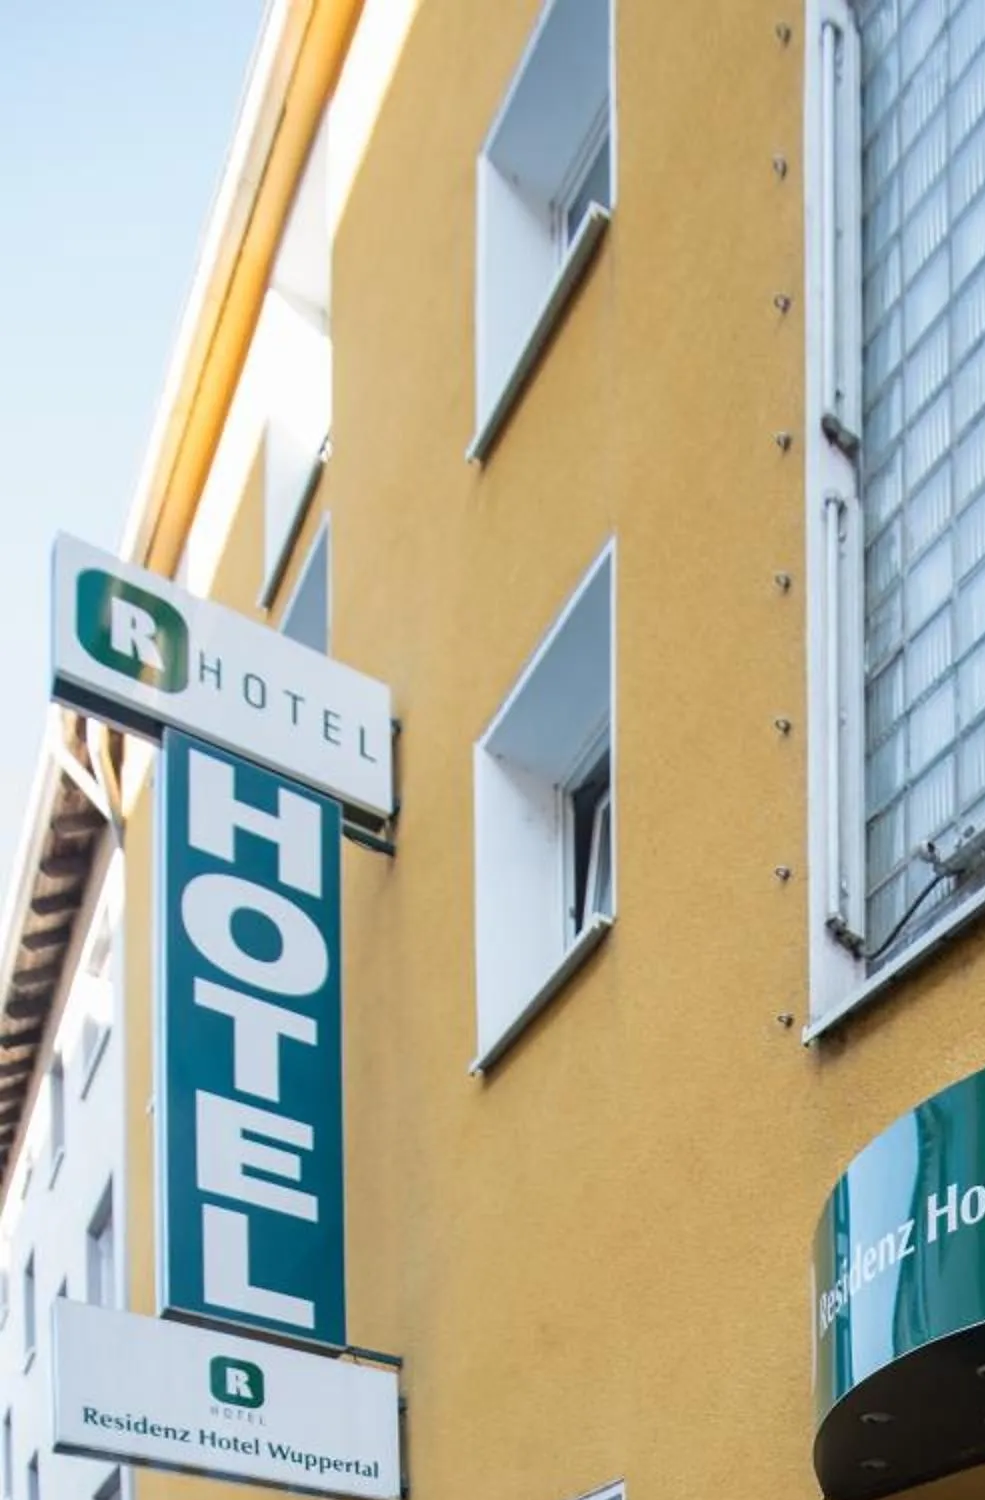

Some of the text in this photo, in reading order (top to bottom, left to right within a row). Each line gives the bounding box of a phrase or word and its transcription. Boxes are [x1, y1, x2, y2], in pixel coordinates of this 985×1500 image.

[200, 652, 378, 764] HOTEL
[180, 748, 330, 1330] HOTEL
[819, 1218, 916, 1338] Residenz
[82, 1406, 380, 1479] Residenz Hotel Wuppertal
[209, 1405, 267, 1427] HOTEL
